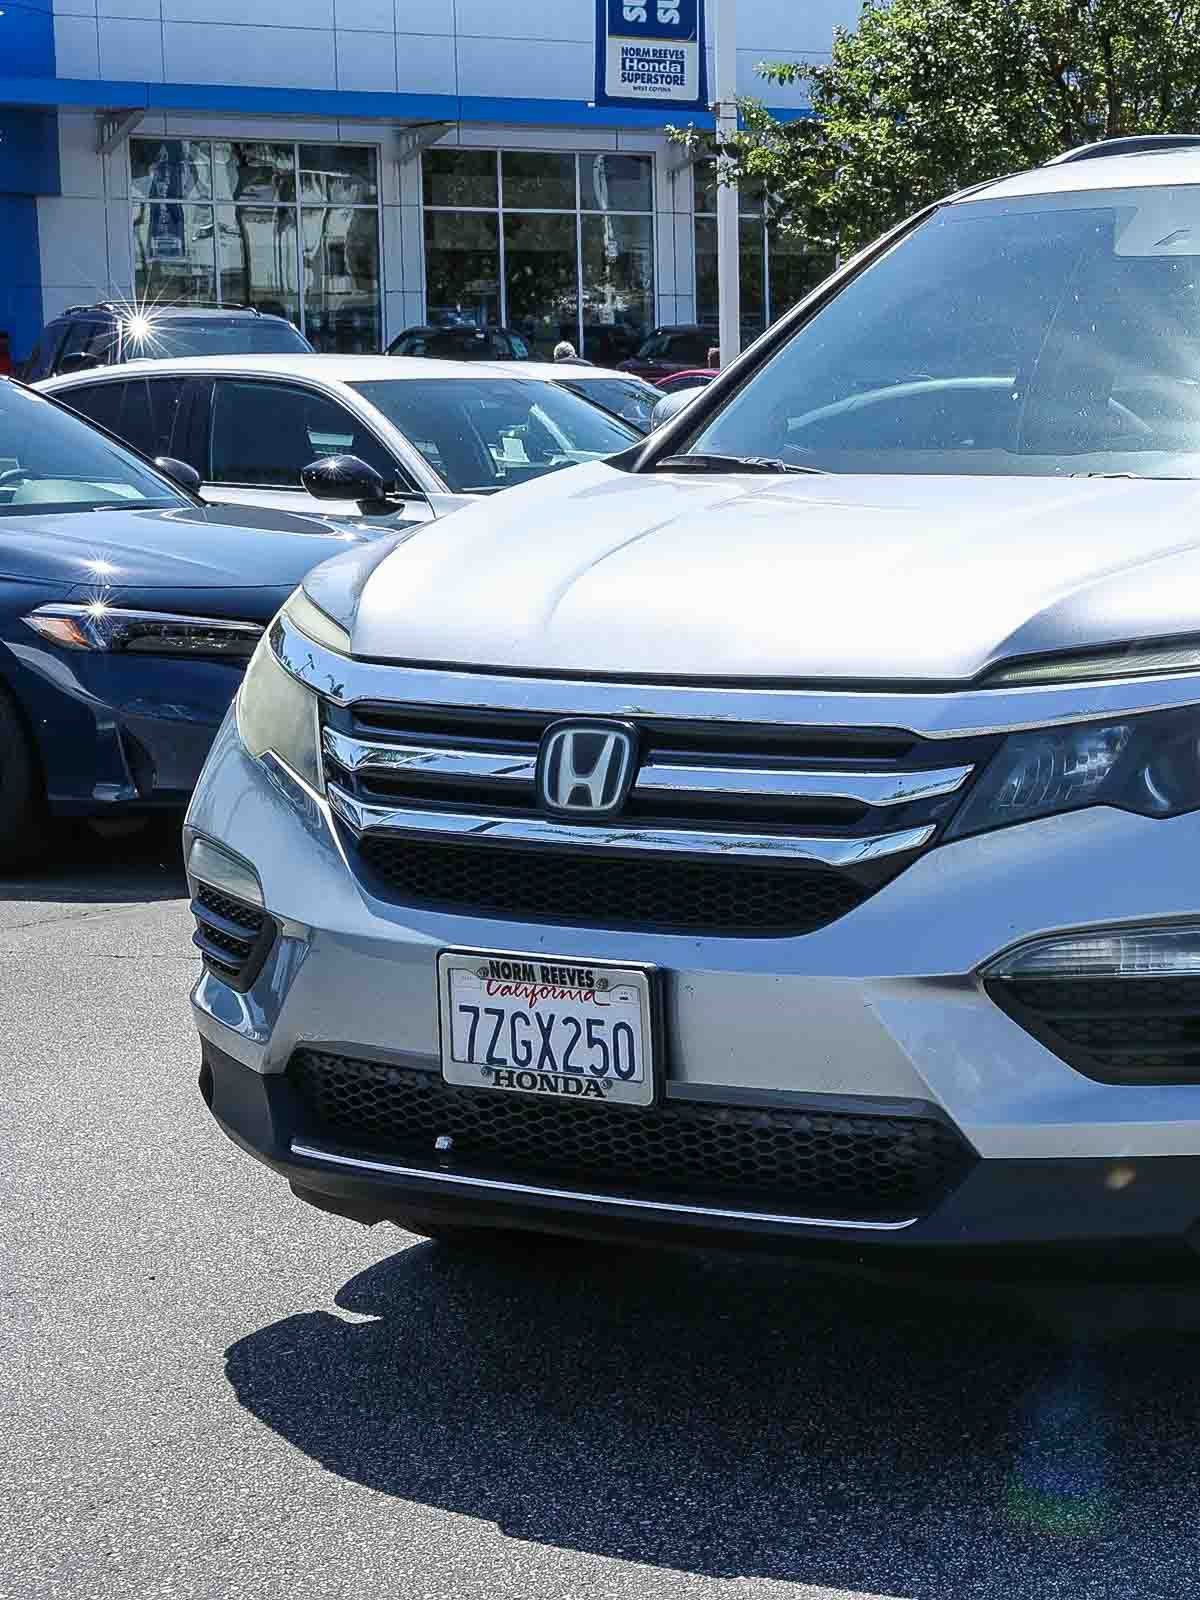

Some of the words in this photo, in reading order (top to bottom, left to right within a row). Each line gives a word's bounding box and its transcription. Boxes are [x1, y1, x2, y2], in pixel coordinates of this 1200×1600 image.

[621, 46, 651, 58] NORM
[652, 48, 685, 60] REEVES
[625, 58, 681, 73] Honda
[621, 72, 686, 86] SUPERSTORE
[488, 959, 536, 982] NORM
[540, 964, 594, 988] REEVES
[486, 978, 610, 1008] California
[458, 1004, 636, 1080] 7ZGX250
[492, 1067, 607, 1098] HONDA
